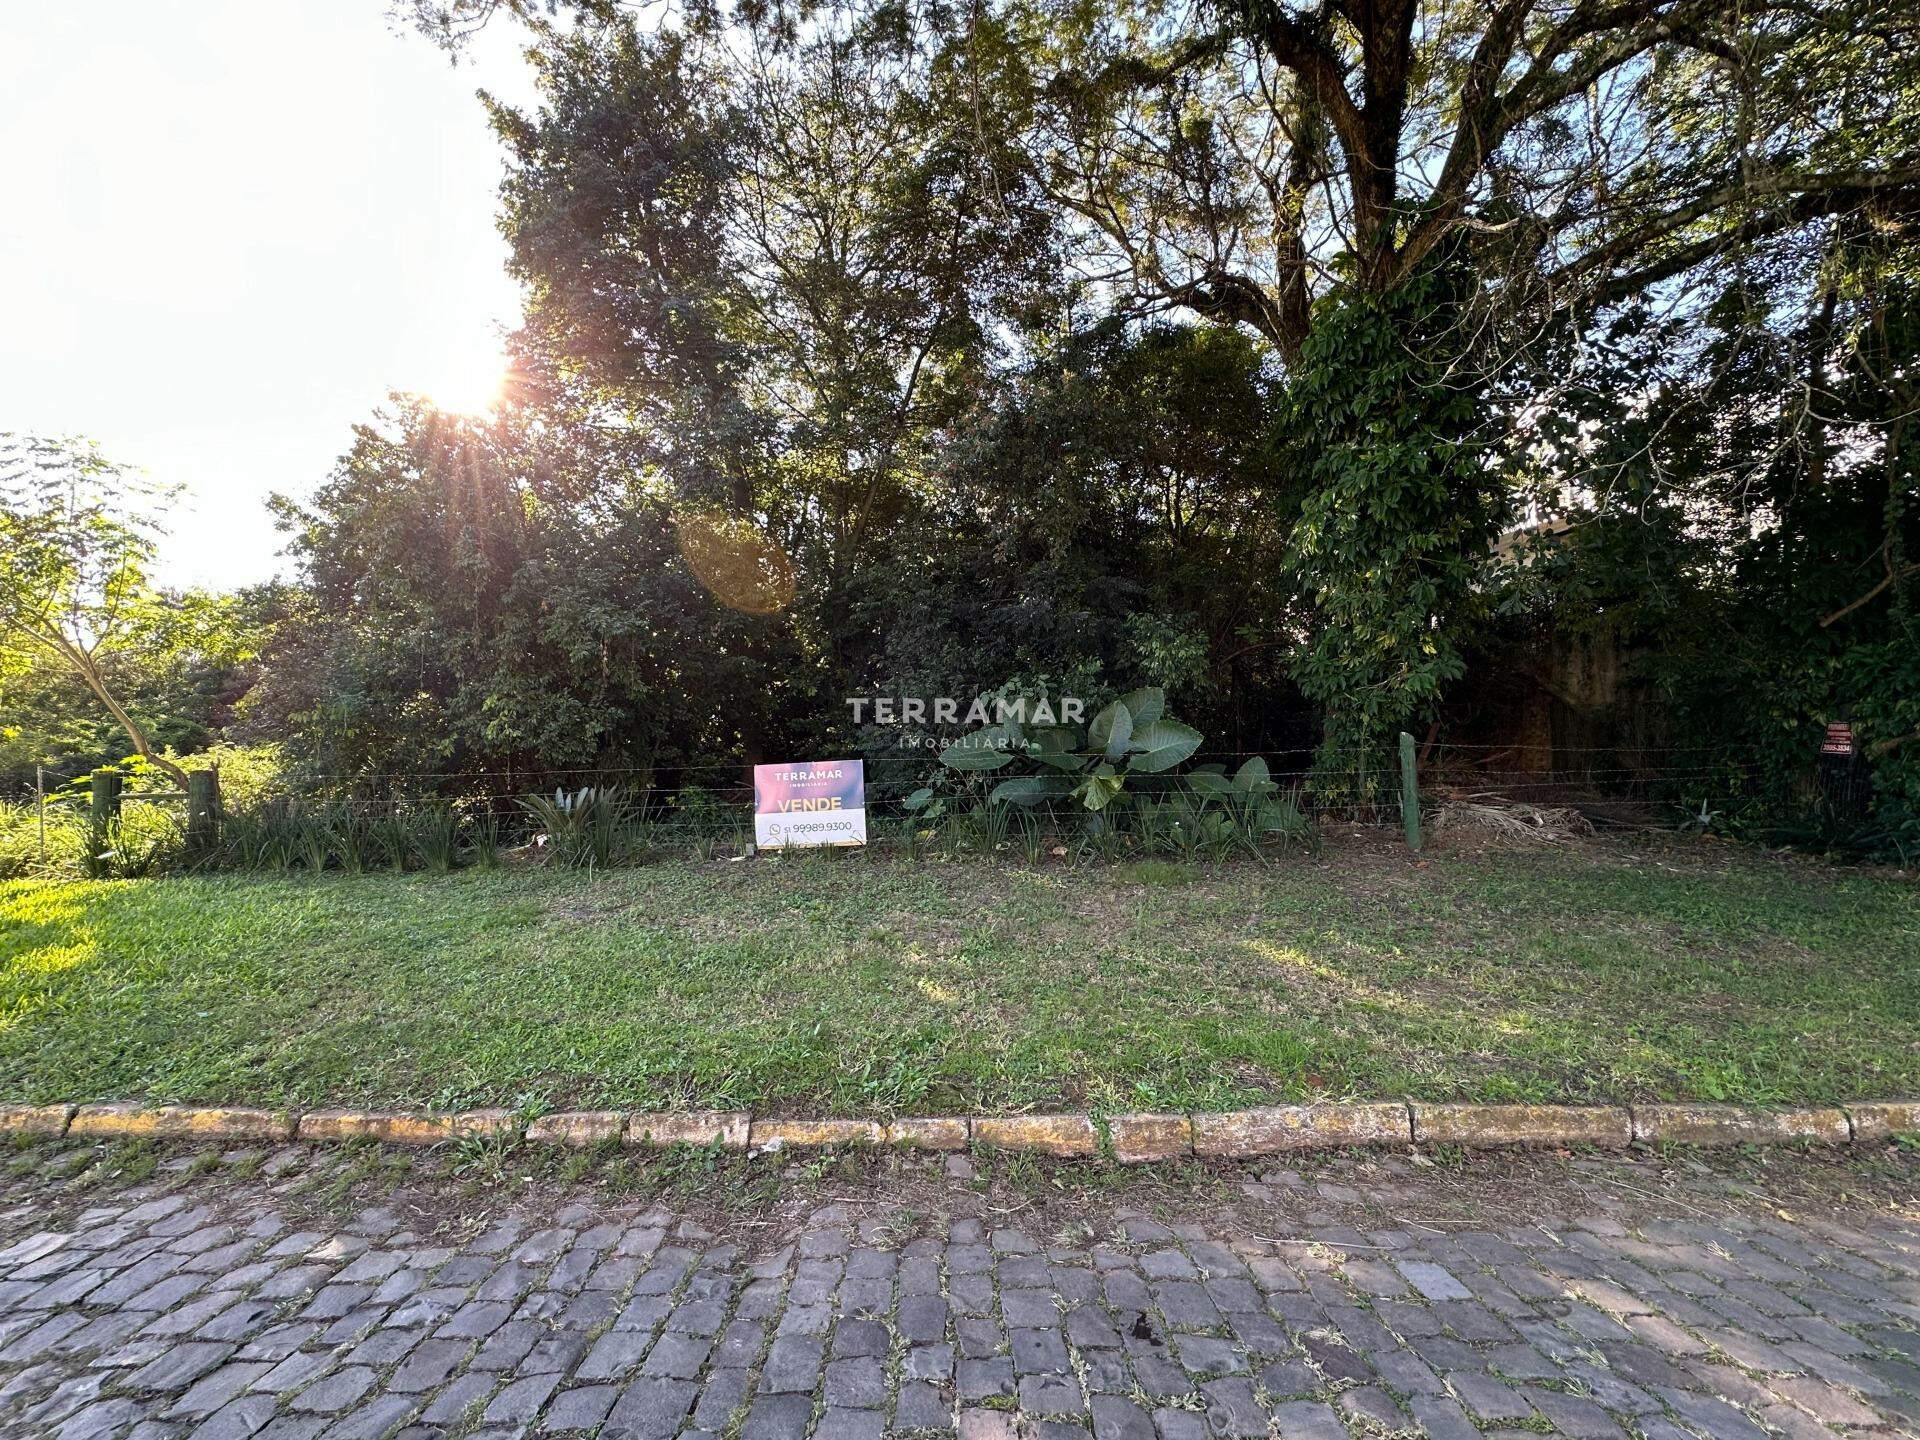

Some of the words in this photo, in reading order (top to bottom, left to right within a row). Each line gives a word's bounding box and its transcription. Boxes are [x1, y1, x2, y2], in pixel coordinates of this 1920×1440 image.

[774, 769, 843, 781] TERRAMAR
[777, 796, 843, 813] VENDE
[792, 821, 852, 833] 99989.9300
